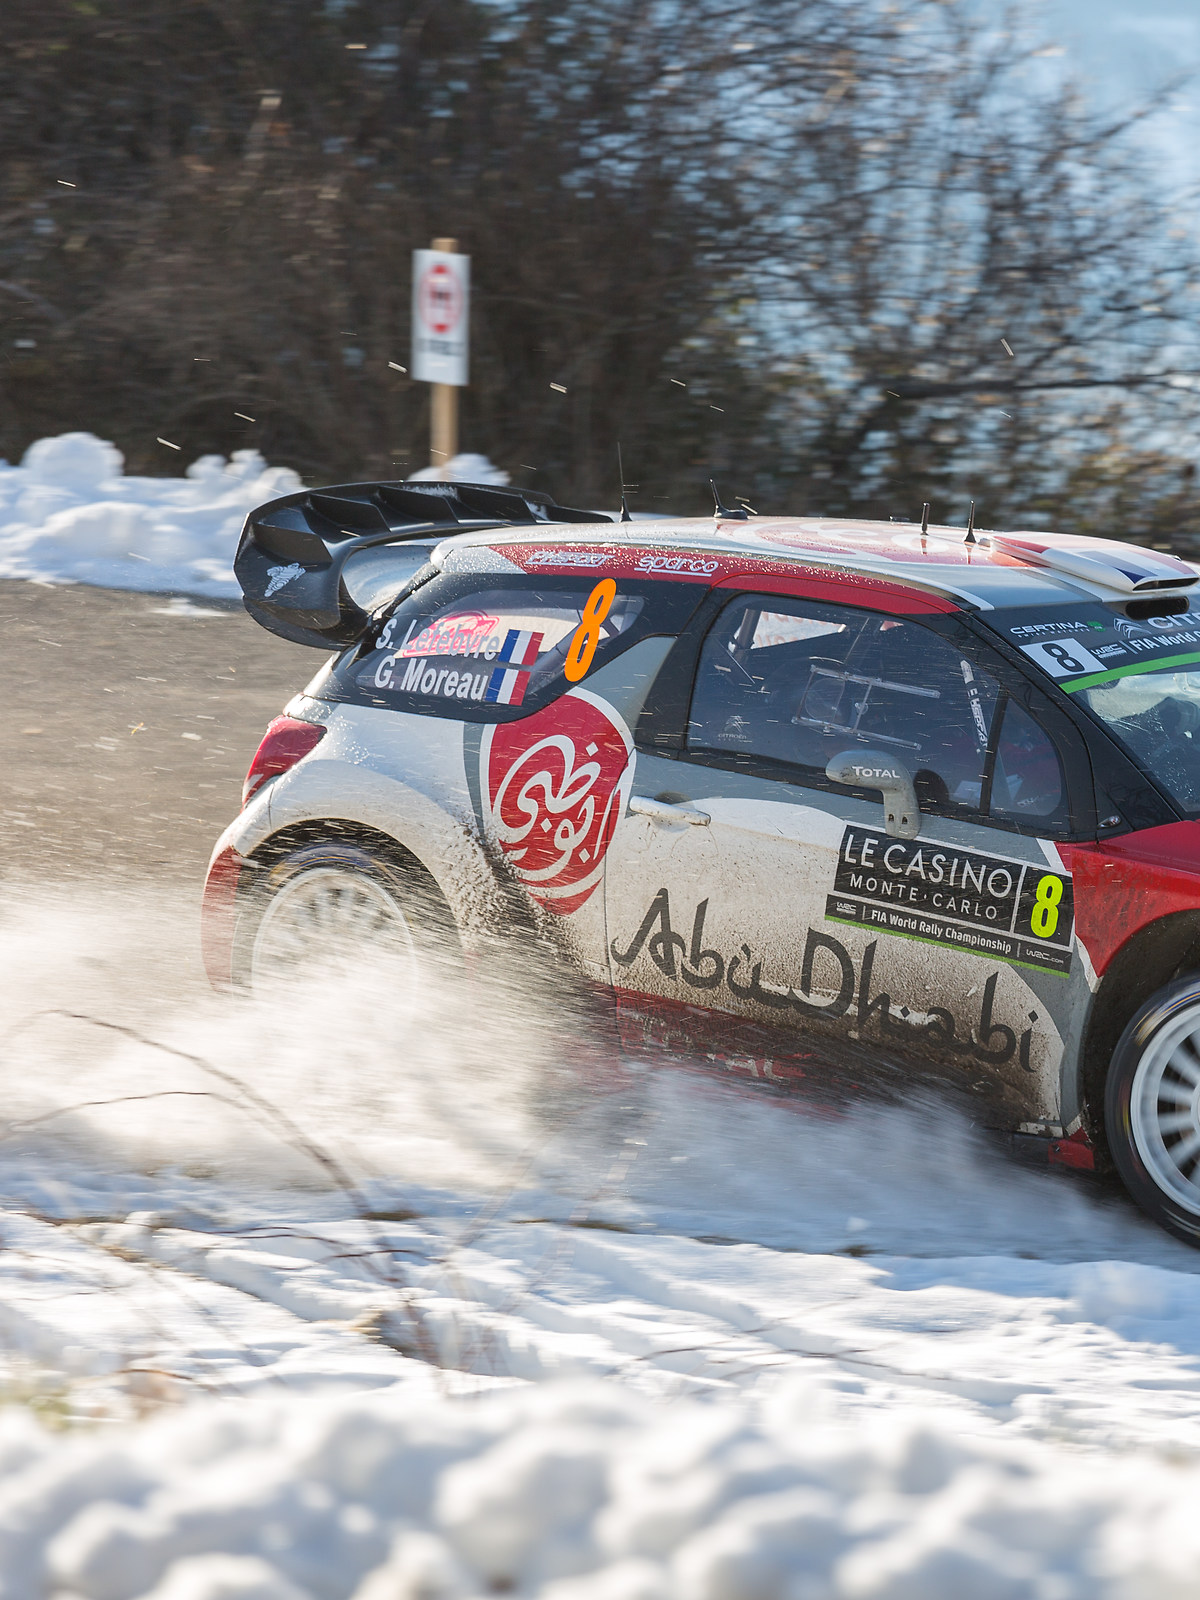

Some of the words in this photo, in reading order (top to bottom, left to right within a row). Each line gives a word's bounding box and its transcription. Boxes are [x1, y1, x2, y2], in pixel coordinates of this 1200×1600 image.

[637, 554, 719, 574] sparco
[375, 618, 398, 649] S.
[400, 619, 500, 661] Lefebvre
[564, 578, 616, 682] 8
[1010, 621, 1088, 635] CERTINA
[1129, 637, 1156, 652] FIA
[1156, 631, 1198, 647] World
[374, 655, 396, 689] G.
[401, 658, 489, 700] Moreau
[1041, 642, 1085, 673] 8
[851, 765, 901, 779] TOTAL
[844, 834, 878, 867] LE
[884, 845, 1012, 897] CASINO
[1030, 875, 1063, 938] 8
[871, 909, 887, 923] FIA
[889, 914, 917, 931] World
[919, 921, 943, 938] Rally
[945, 928, 1012, 954] Championship
